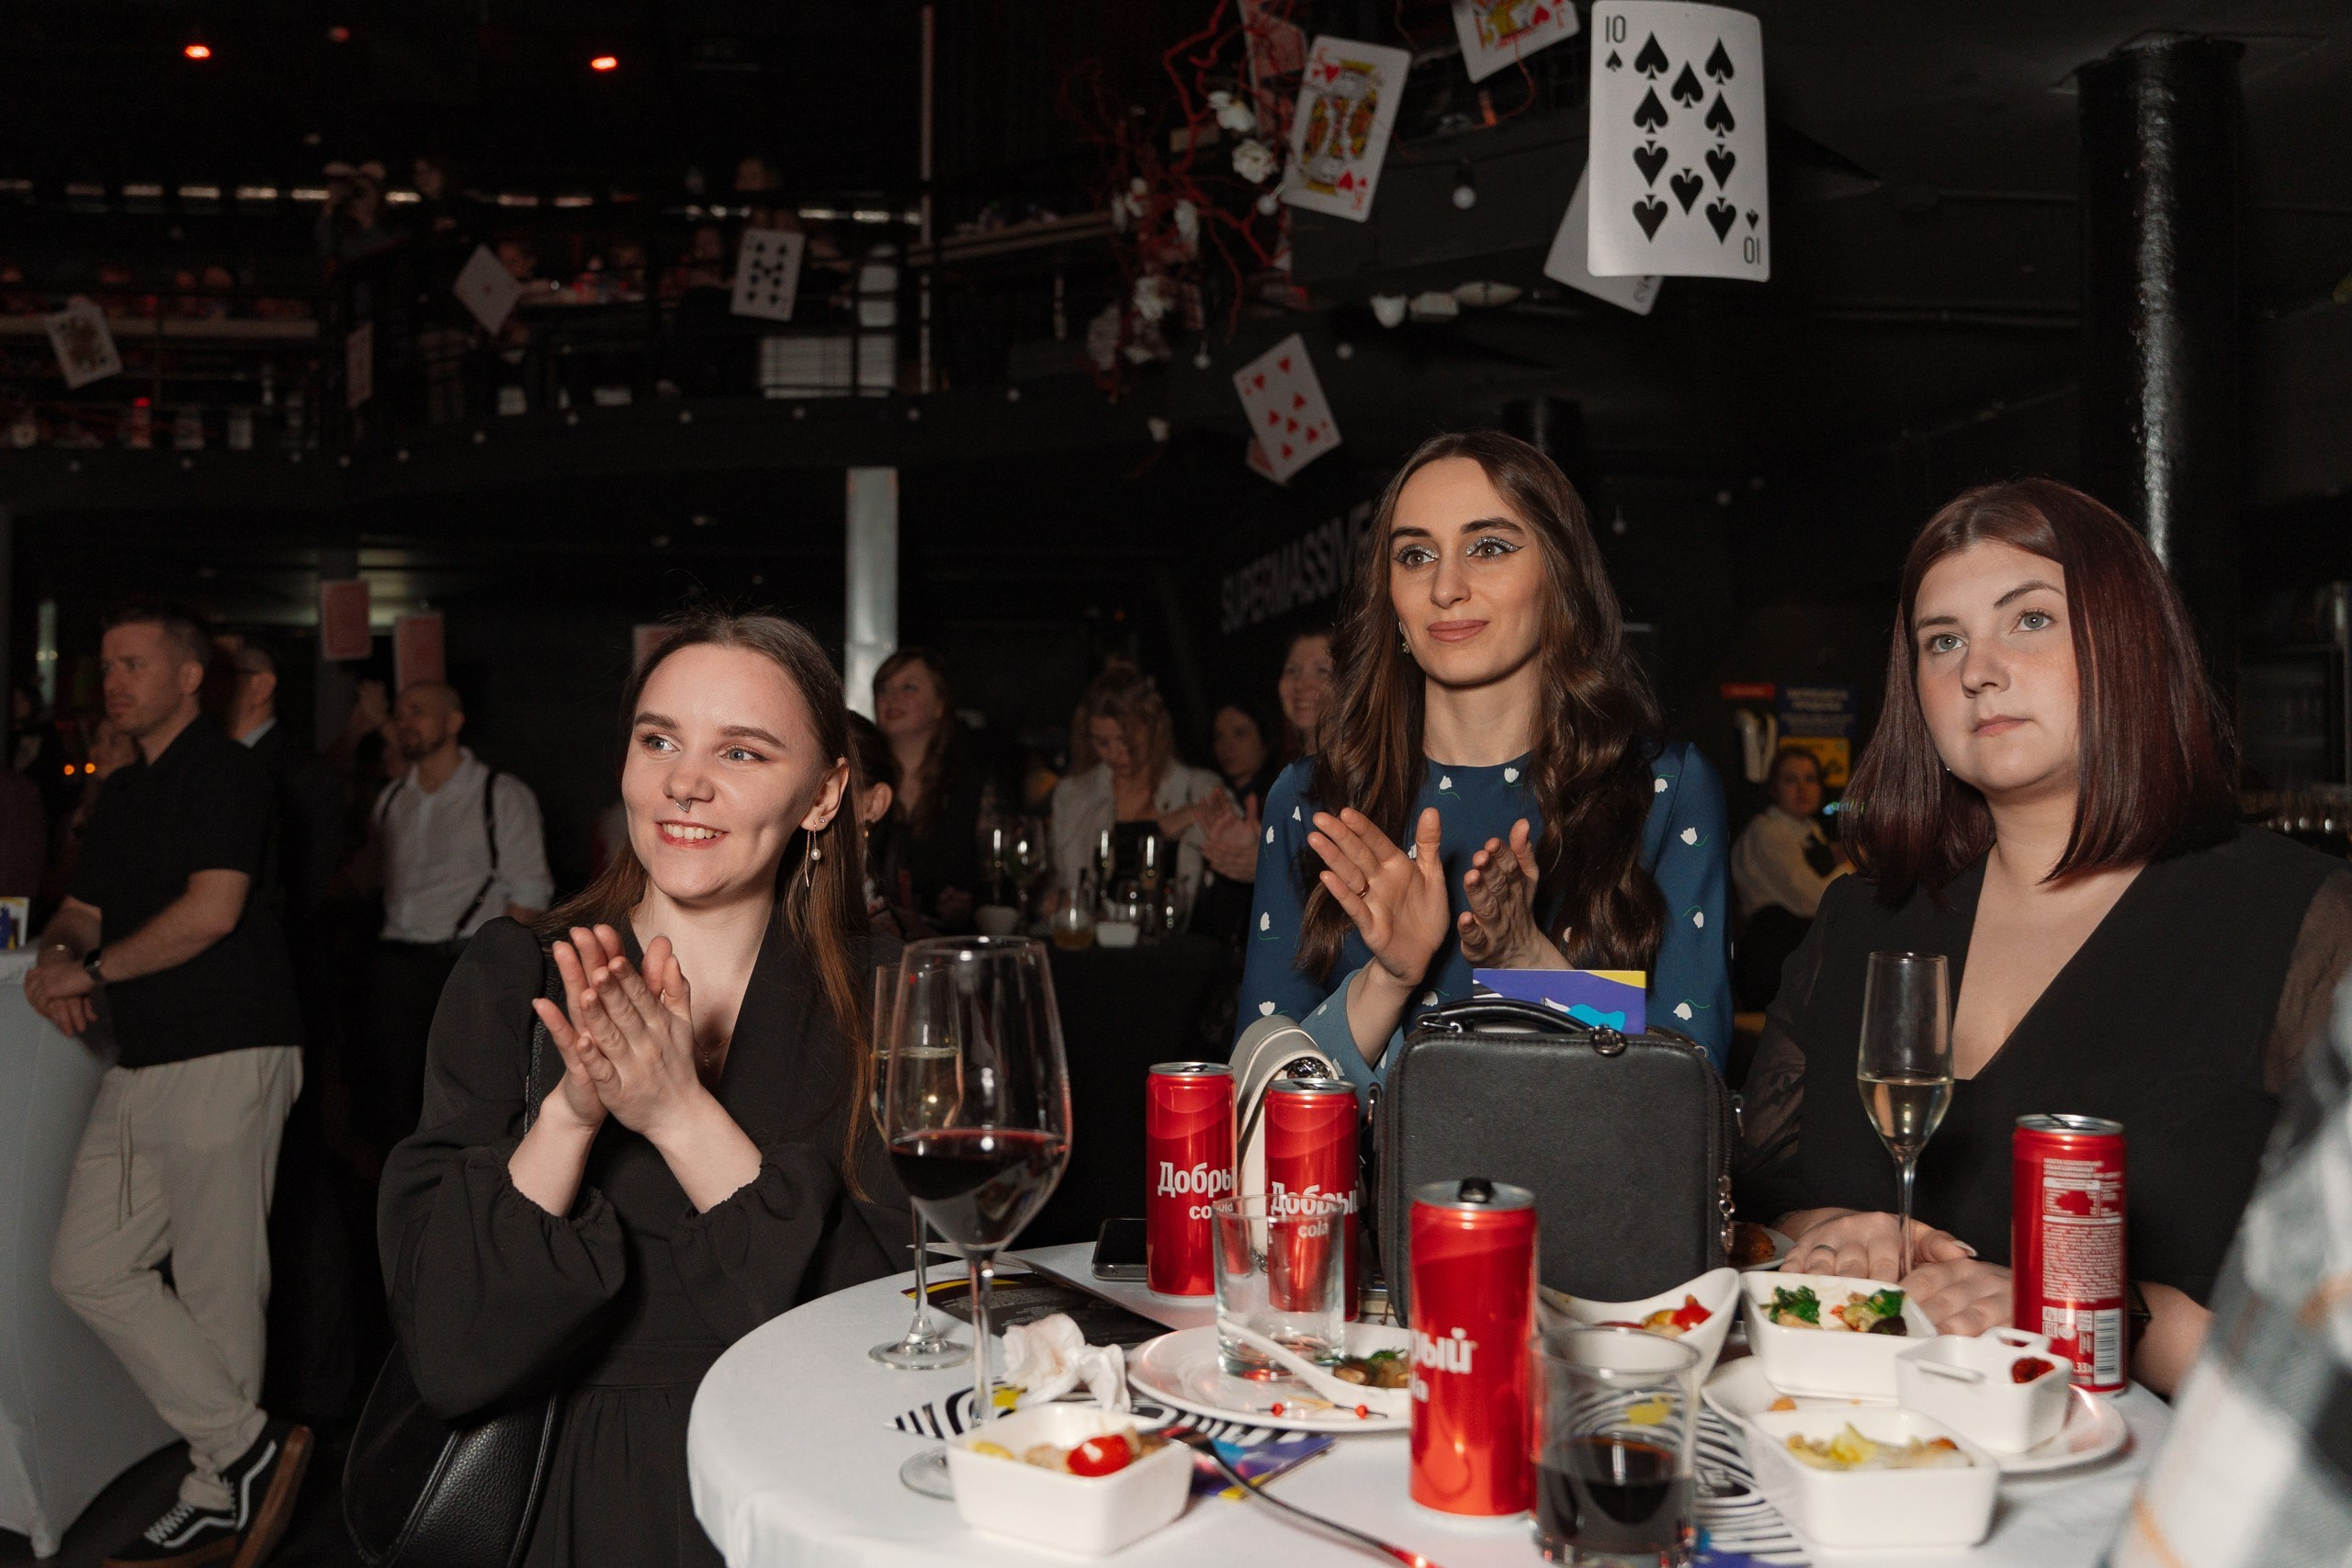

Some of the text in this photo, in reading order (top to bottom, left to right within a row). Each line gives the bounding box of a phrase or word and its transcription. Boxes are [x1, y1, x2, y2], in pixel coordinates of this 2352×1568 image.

[1605, 15, 1626, 43] 10
[1743, 236, 1761, 265] 10
[1157, 1161, 1233, 1198] Добры
[1297, 1220, 1329, 1238] cola
